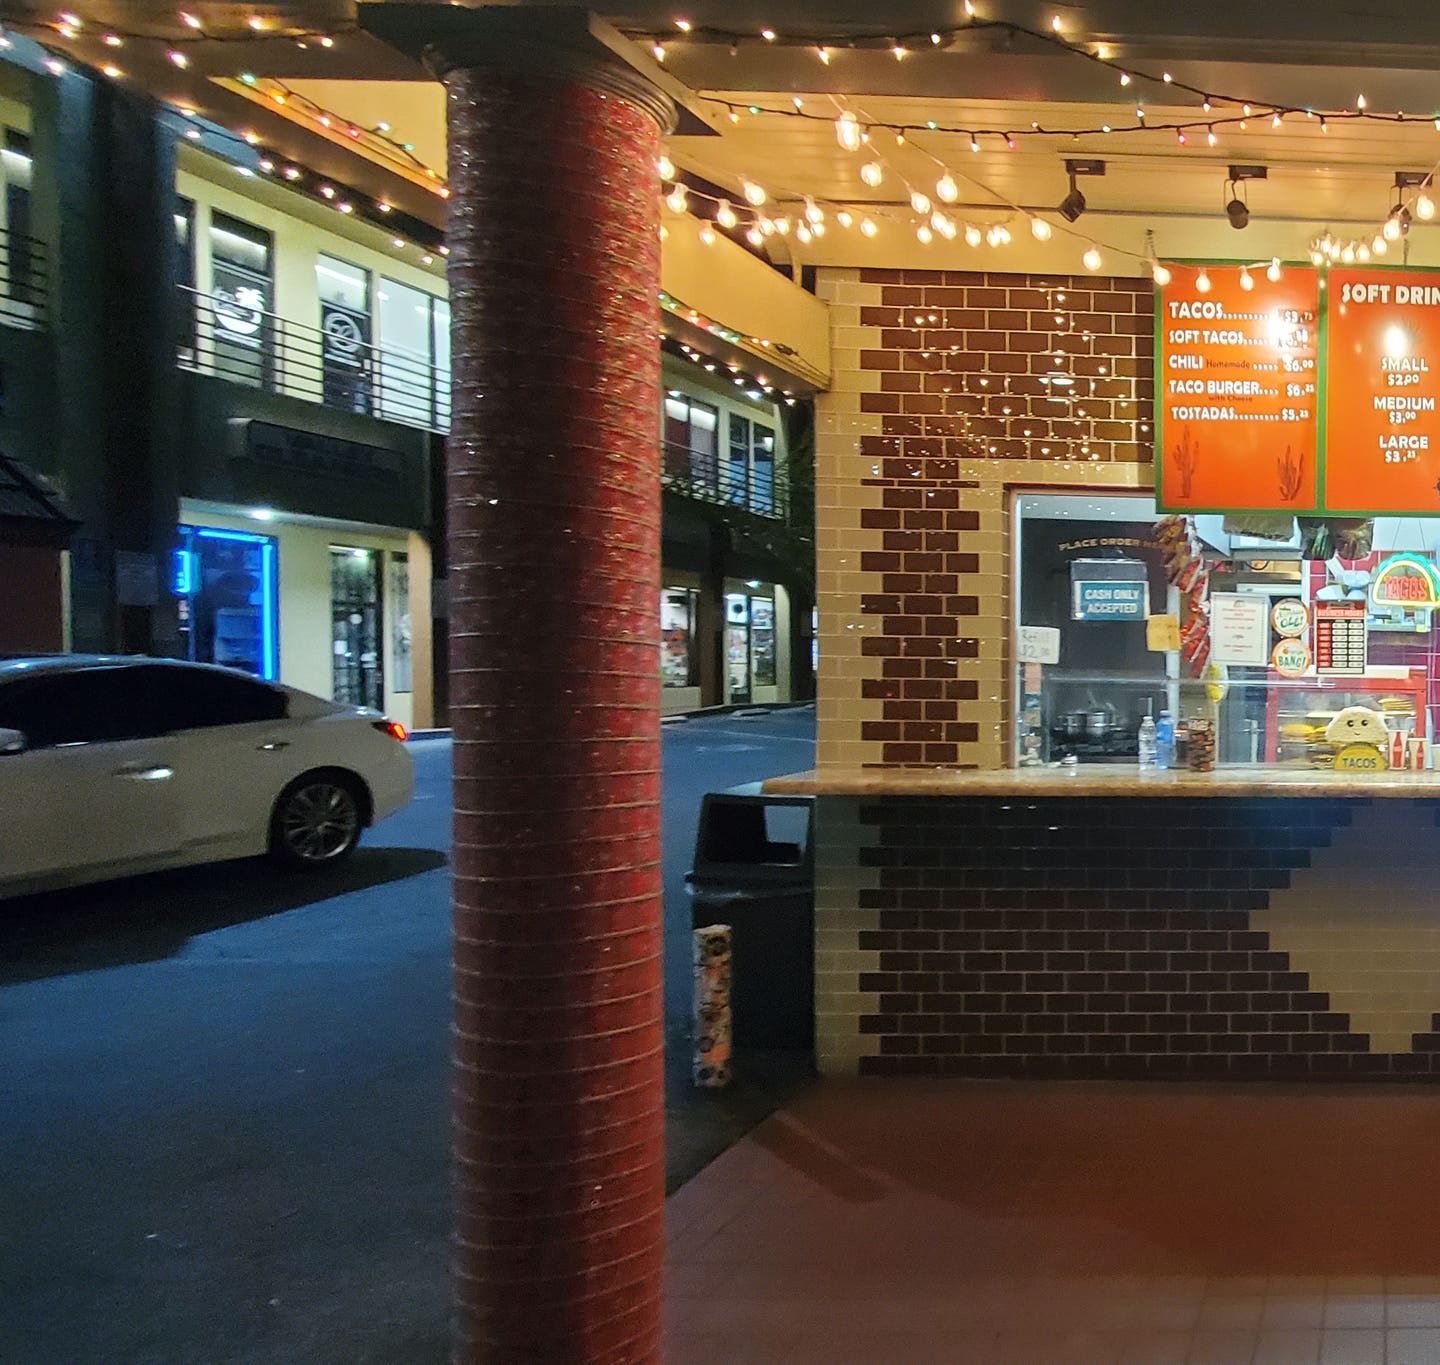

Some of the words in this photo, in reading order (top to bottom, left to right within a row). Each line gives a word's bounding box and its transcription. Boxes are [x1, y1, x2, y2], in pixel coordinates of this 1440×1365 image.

[1341, 283, 1391, 304] SOFT
[1169, 330, 1200, 345] SOFT
[1169, 355, 1203, 369] CHILI
[1381, 357, 1429, 372] SMALL
[1169, 379, 1204, 394] TACO
[1373, 396, 1435, 411] MEDIUM
[1379, 435, 1429, 449] LARGE
[1059, 538, 1098, 551] PLACE
[1099, 537, 1140, 547] ORDER
[1084, 589, 1112, 600] CASH
[1113, 589, 1139, 600] ONLY
[1384, 575, 1428, 601] TACOS
[1087, 602, 1138, 614] ACCEPTED
[1278, 655, 1306, 669] BANG!
[1342, 756, 1377, 769] TACOS
